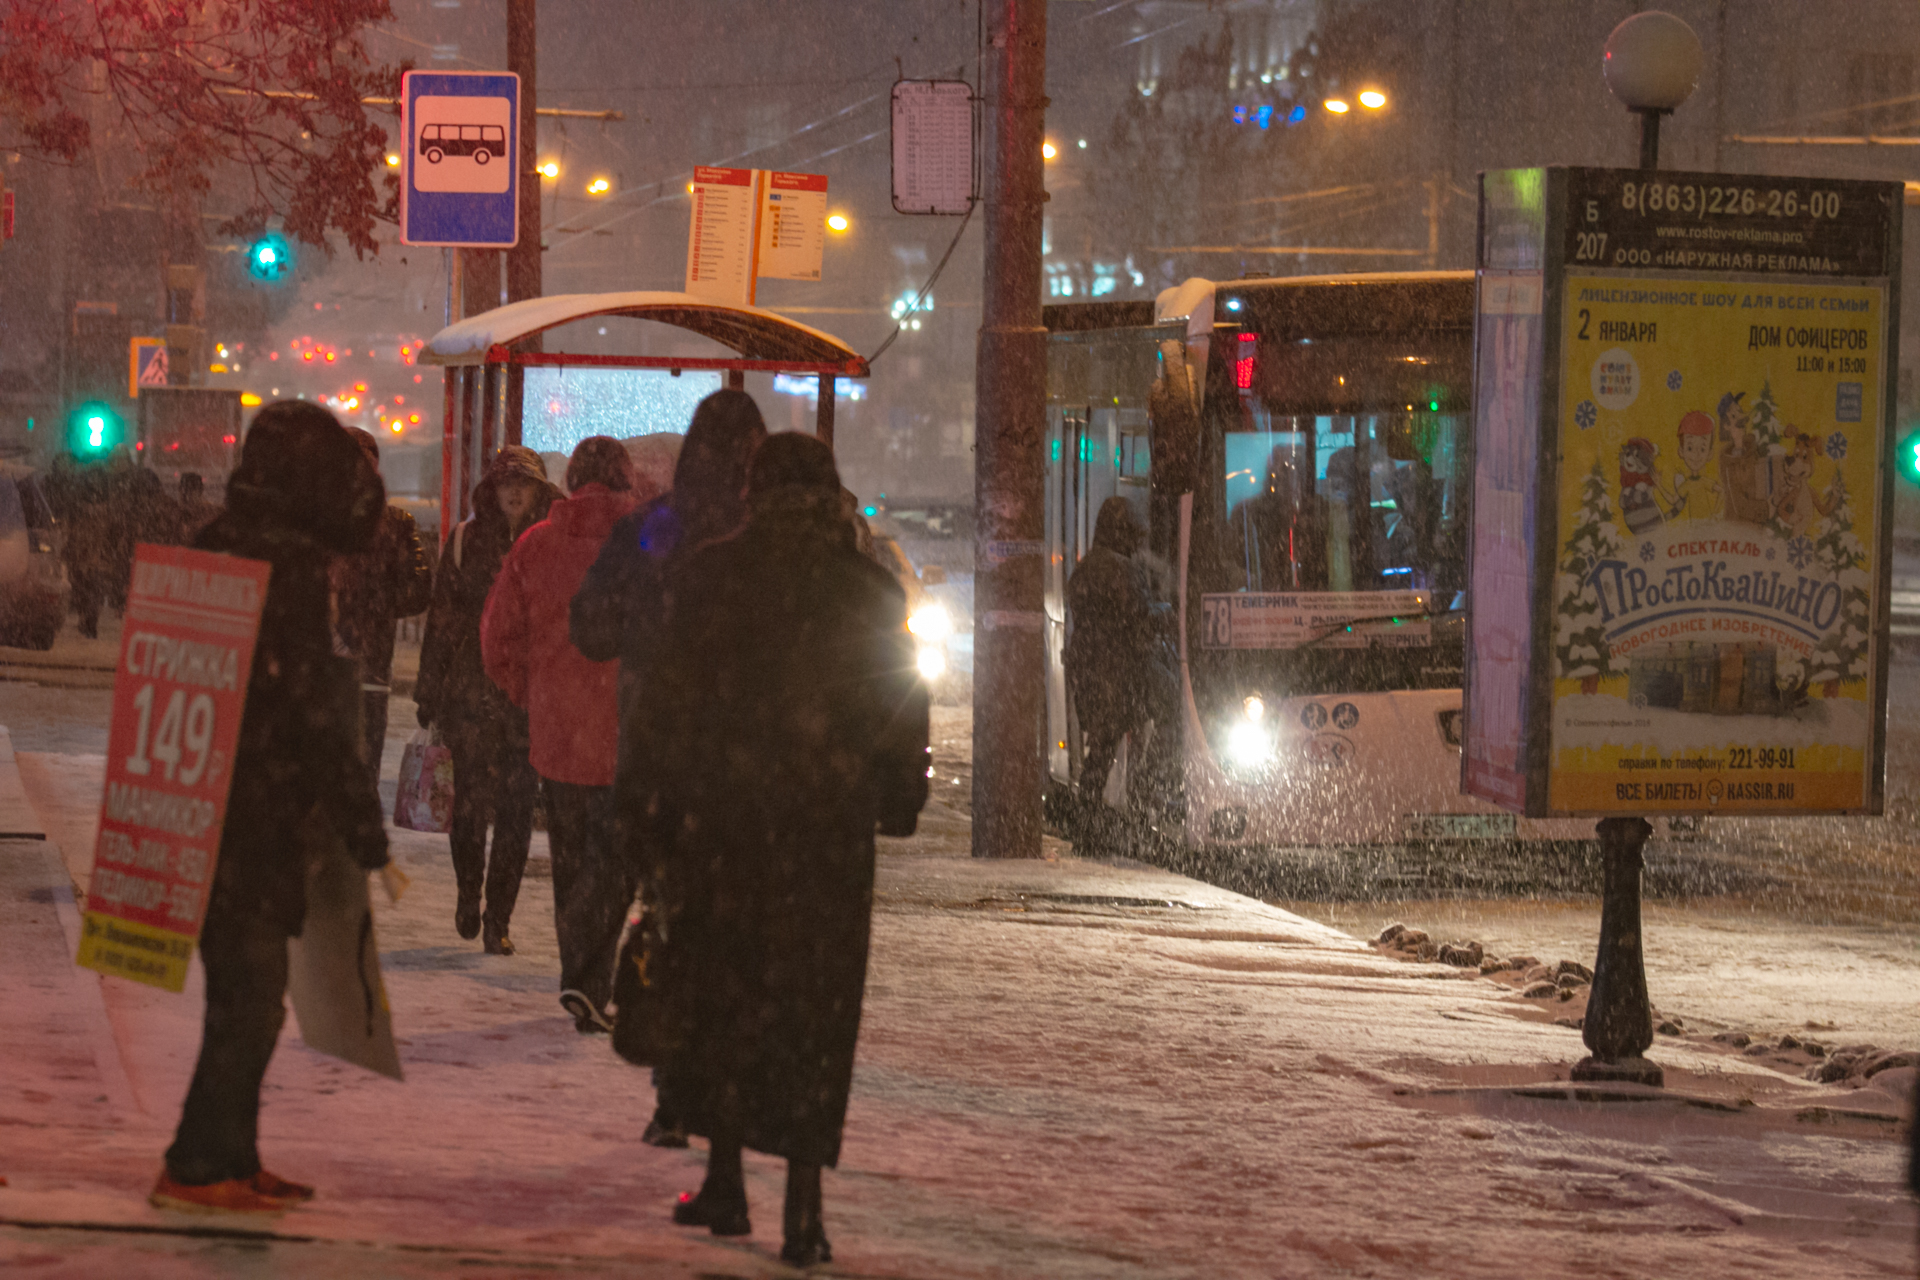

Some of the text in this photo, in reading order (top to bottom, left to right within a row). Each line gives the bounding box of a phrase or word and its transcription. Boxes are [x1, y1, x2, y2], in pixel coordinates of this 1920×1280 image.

[1586, 200, 1599, 222] Б
[1622, 182, 1840, 219] 8(863)226-26-00
[1576, 232, 1608, 260] 207
[1656, 226, 1803, 245] www.rostov-reklama.pro
[1615, 248, 1840, 272] ООО «НАРУЖНАЯ РЕКЛАМА»
[1578, 288, 1697, 307] ЛИЦЕНЗИОННОЕ
[1702, 293, 1737, 308] ШОУ
[1741, 295, 1773, 310] ДЛЯ
[1819, 298, 1869, 313] СЕМЬИ
[1577, 308, 1657, 343] 2 ЯНВАРЯ
[1748, 325, 1868, 353] ДОМ ОФИЦЕРОВ
[1796, 356, 1824, 373] 11:00
[1839, 358, 1866, 374] 15:00
[1667, 539, 1762, 558] СПЕКТАКЛЬ
[1235, 595, 1299, 609] ТЕМЕРНИК
[1204, 600, 1231, 645] 78
[1610, 617, 1814, 660] НОВОГОДНЕЕ ИЗОБРЕТЕНИЕ
[126, 631, 239, 692] СТРИЖКА
[126, 684, 215, 787] 149
[1618, 748, 1795, 772] справки по телефону: 221-99-91
[1616, 782, 1795, 801] ВСЕ БИЛЕТЫ KASSIR.RU
[106, 781, 215, 839] МАНИКЮР
